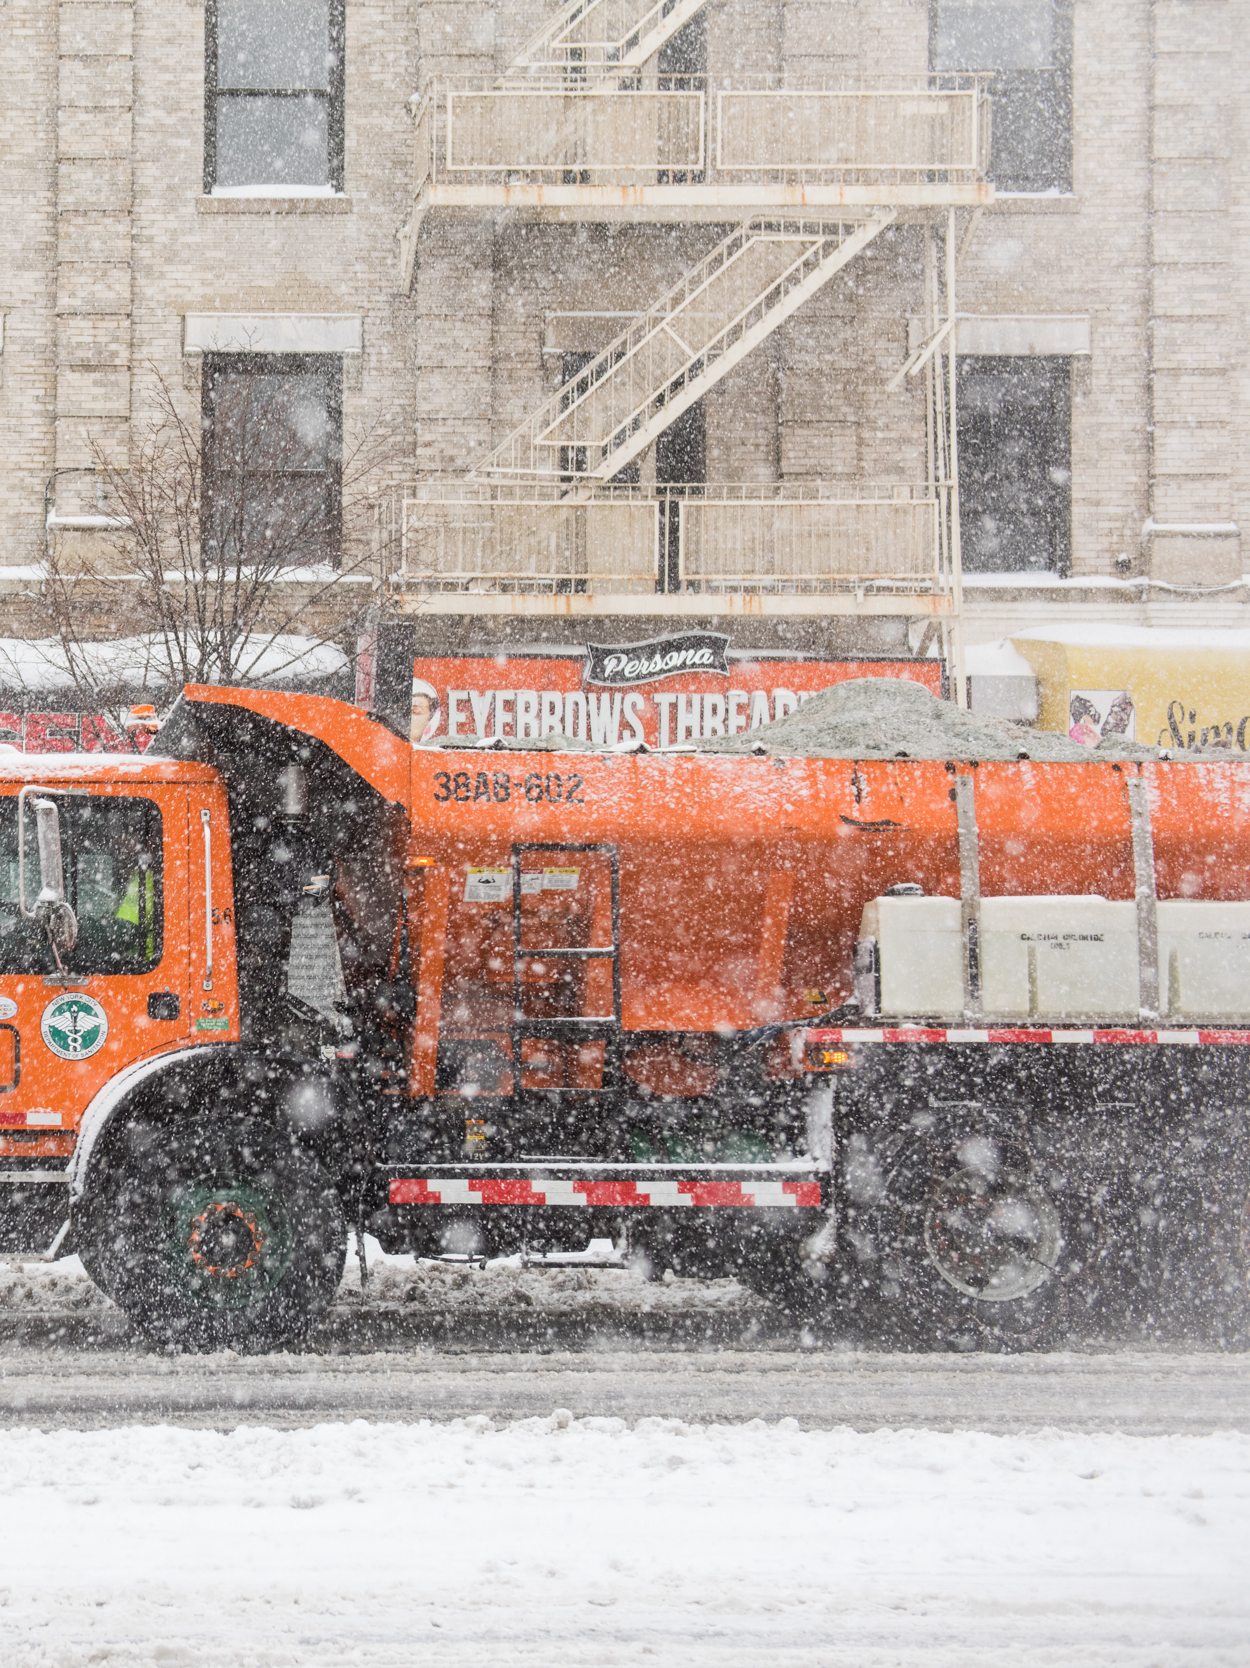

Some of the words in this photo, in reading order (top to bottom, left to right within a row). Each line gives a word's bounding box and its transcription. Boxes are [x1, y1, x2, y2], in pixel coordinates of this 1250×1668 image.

[603, 648, 714, 678] Persona
[448, 690, 645, 745] EYEBROWS
[433, 771, 585, 804] 38AB-602
[51, 996, 65, 1007] NEW
[84, 996, 99, 1007] CITY
[43, 1030, 71, 1058] DEPARTMENT
[80, 1030, 106, 1058] SANITATION
